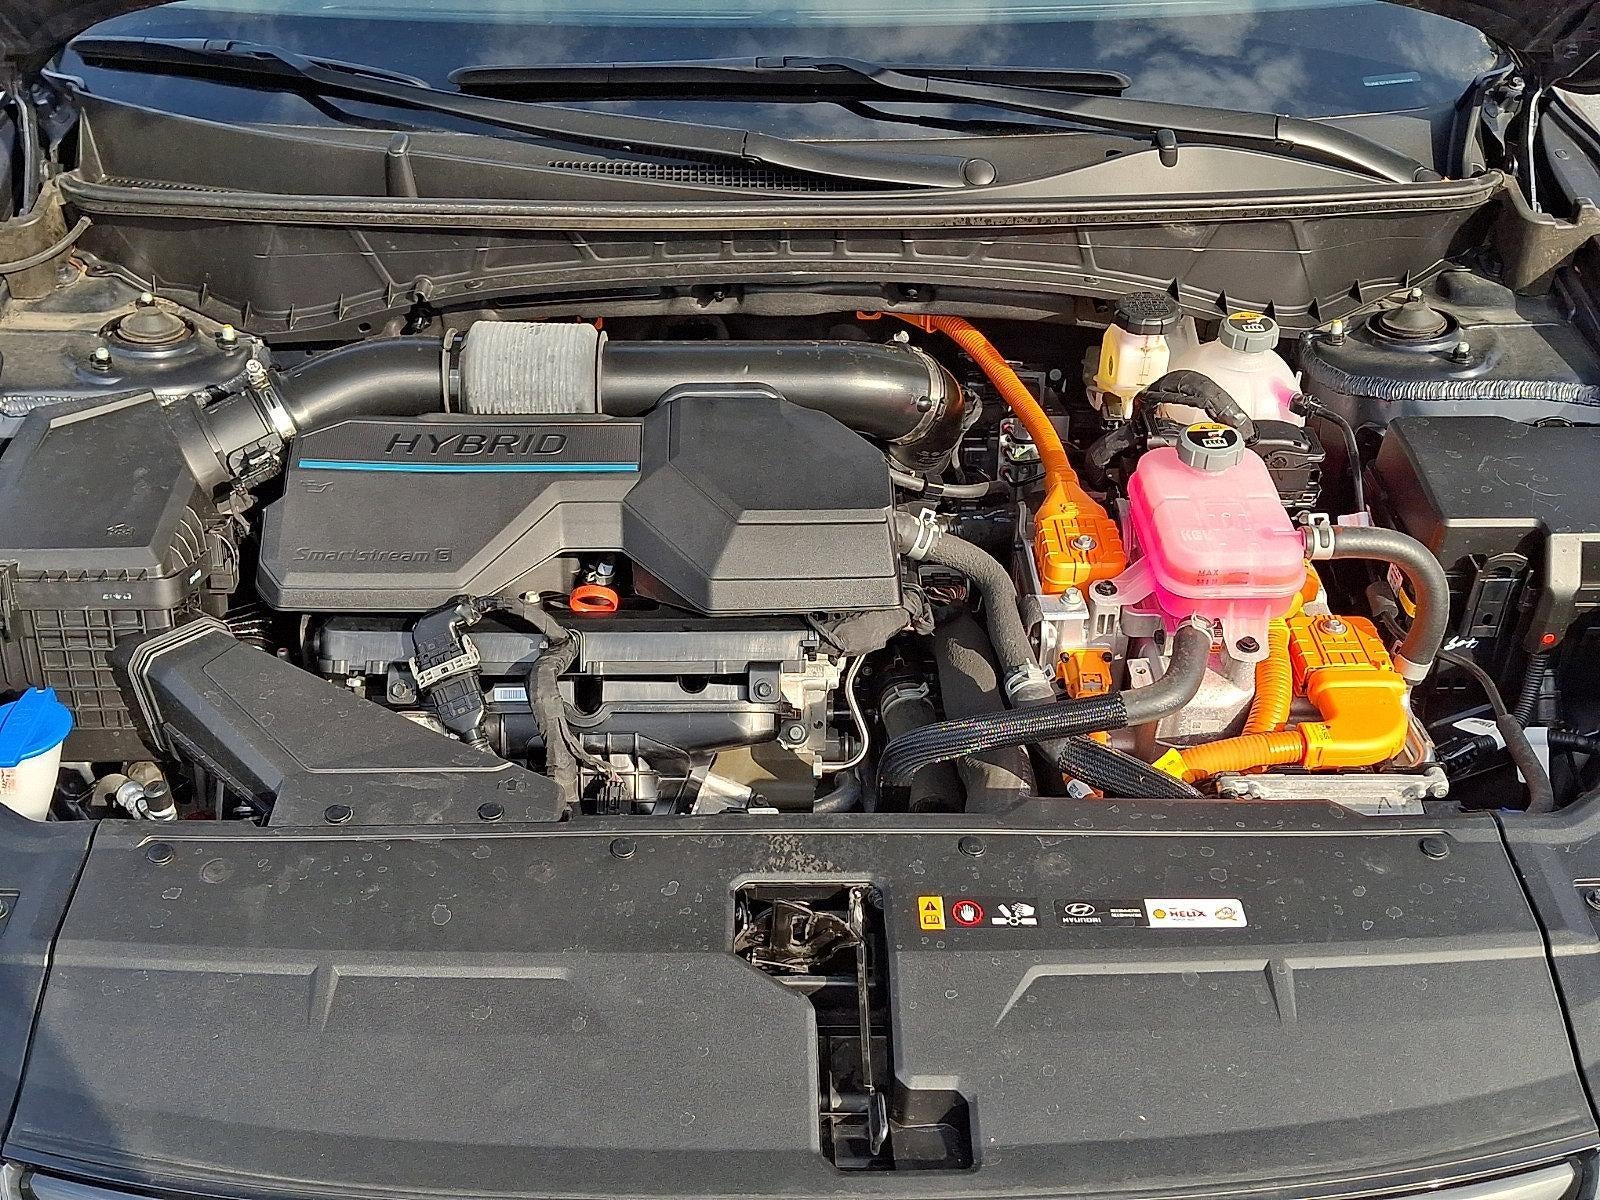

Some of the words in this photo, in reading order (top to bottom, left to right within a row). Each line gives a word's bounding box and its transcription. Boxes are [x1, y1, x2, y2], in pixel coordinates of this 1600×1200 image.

[384, 432, 569, 457] HYBRID
[292, 547, 431, 562] Smartstream
[1197, 569, 1219, 577] MAX
[1169, 909, 1207, 918] HELIX
